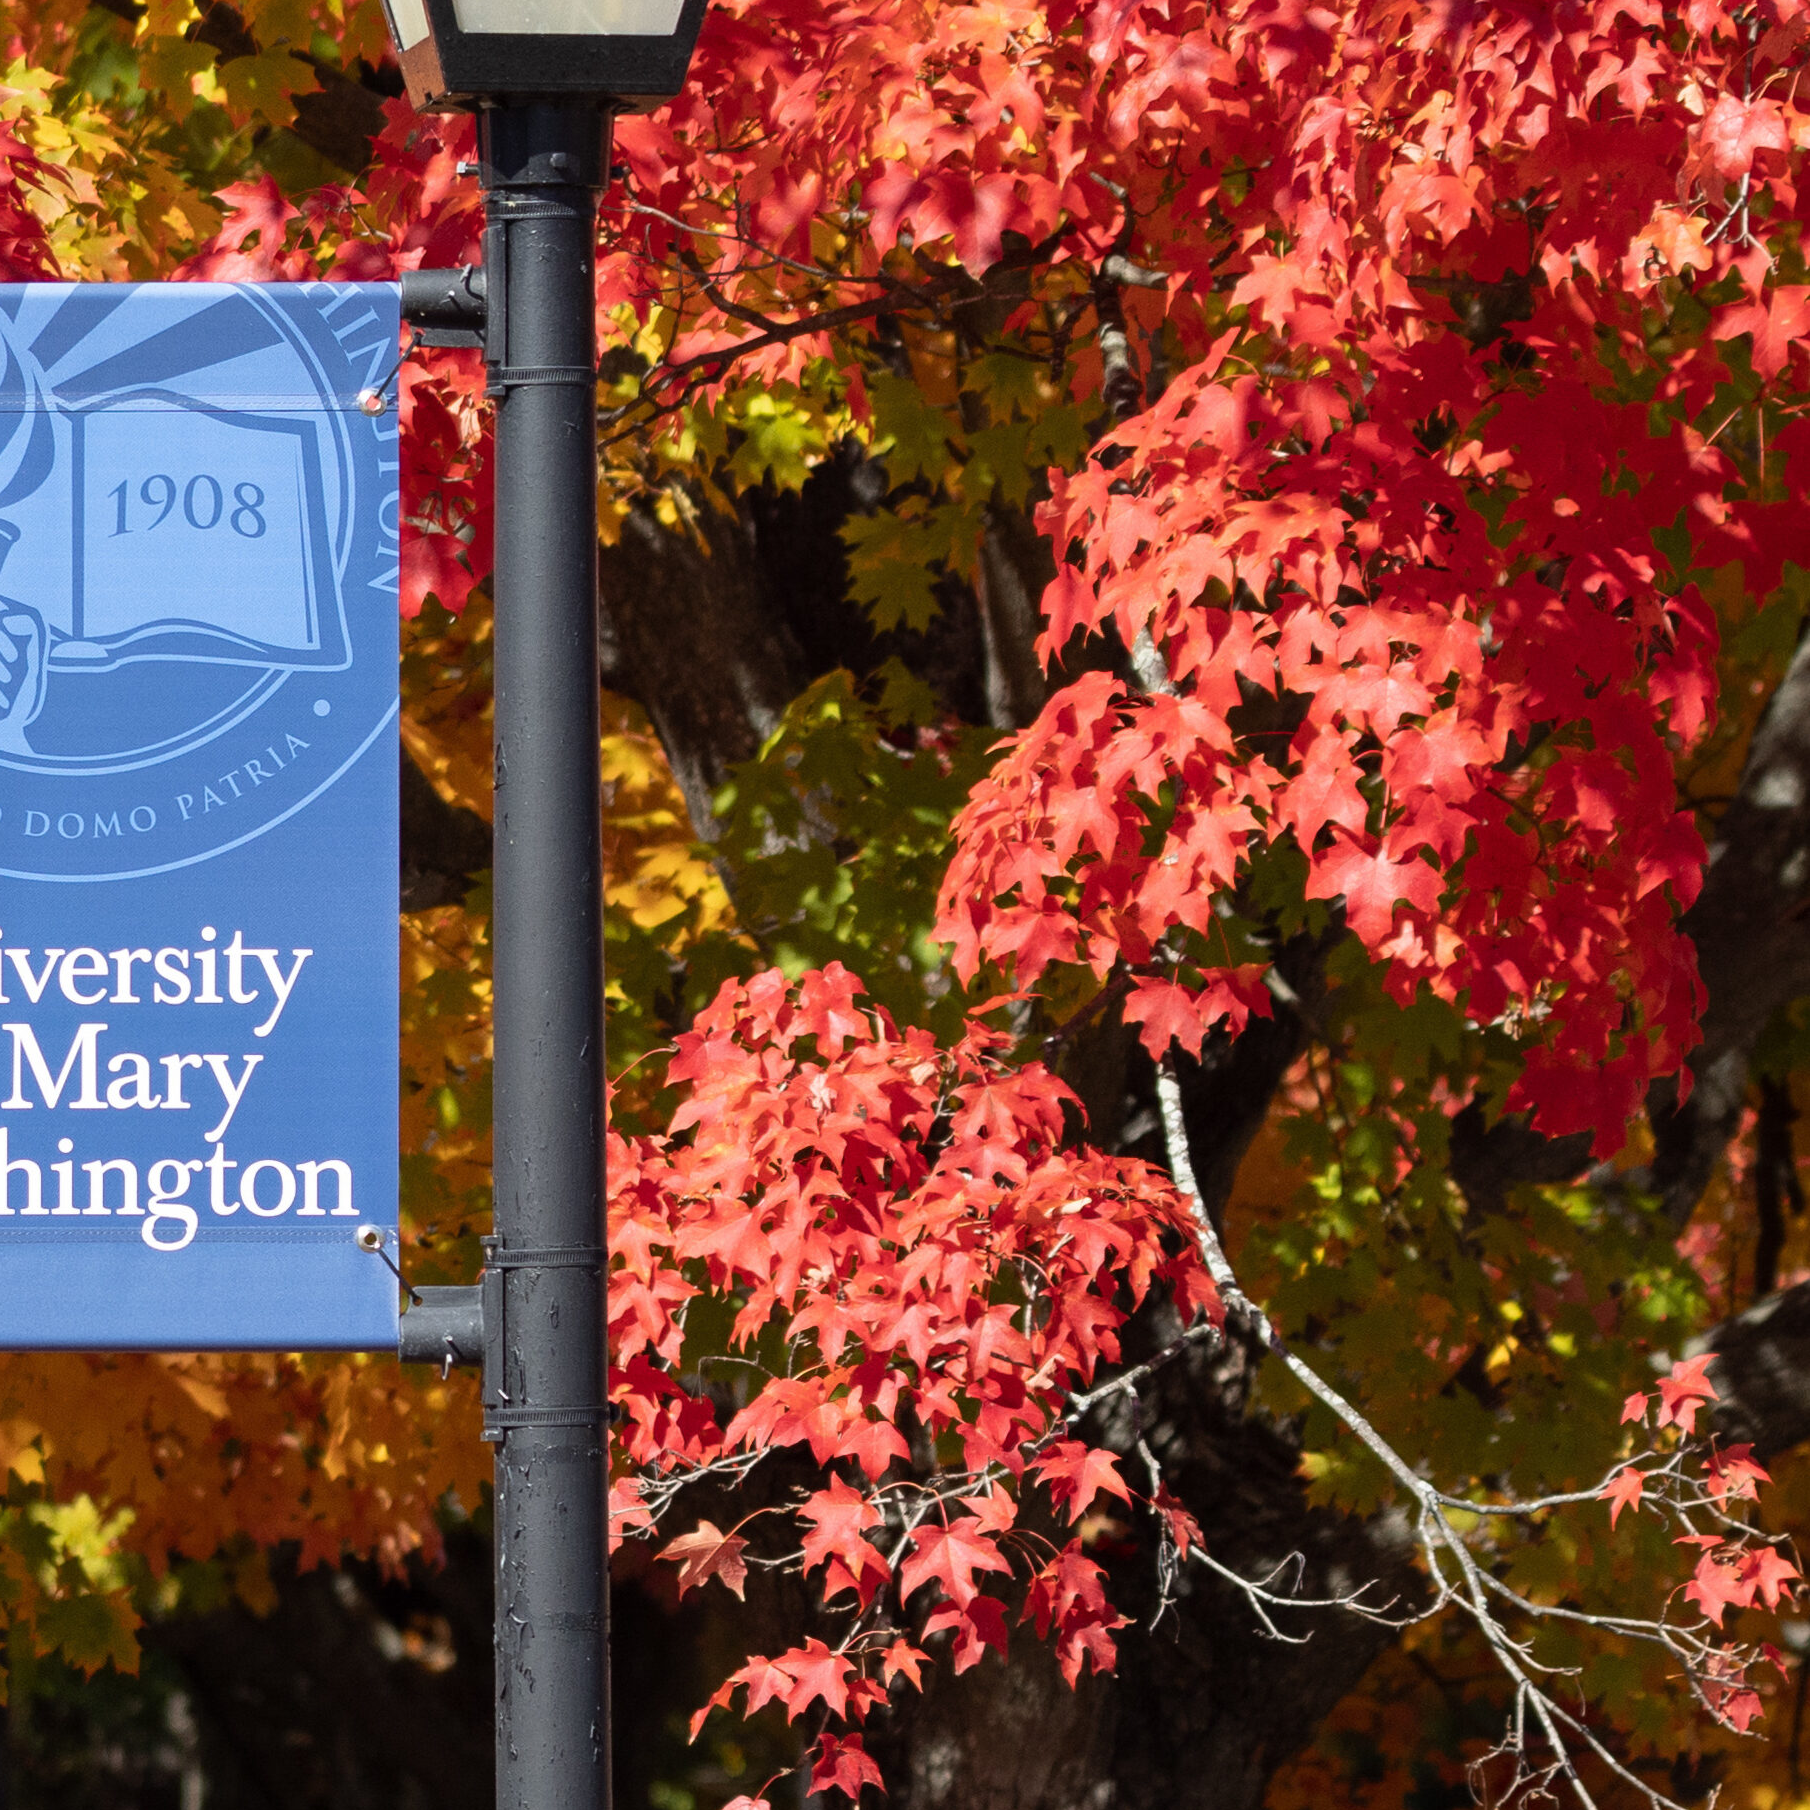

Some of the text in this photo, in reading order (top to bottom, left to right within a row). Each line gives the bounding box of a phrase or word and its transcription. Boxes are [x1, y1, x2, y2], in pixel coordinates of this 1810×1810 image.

[107, 474, 267, 539] 1908
[23, 805, 157, 840] DOMO
[175, 733, 311, 821] PATRIA
[1, 1024, 263, 1143] Mary
